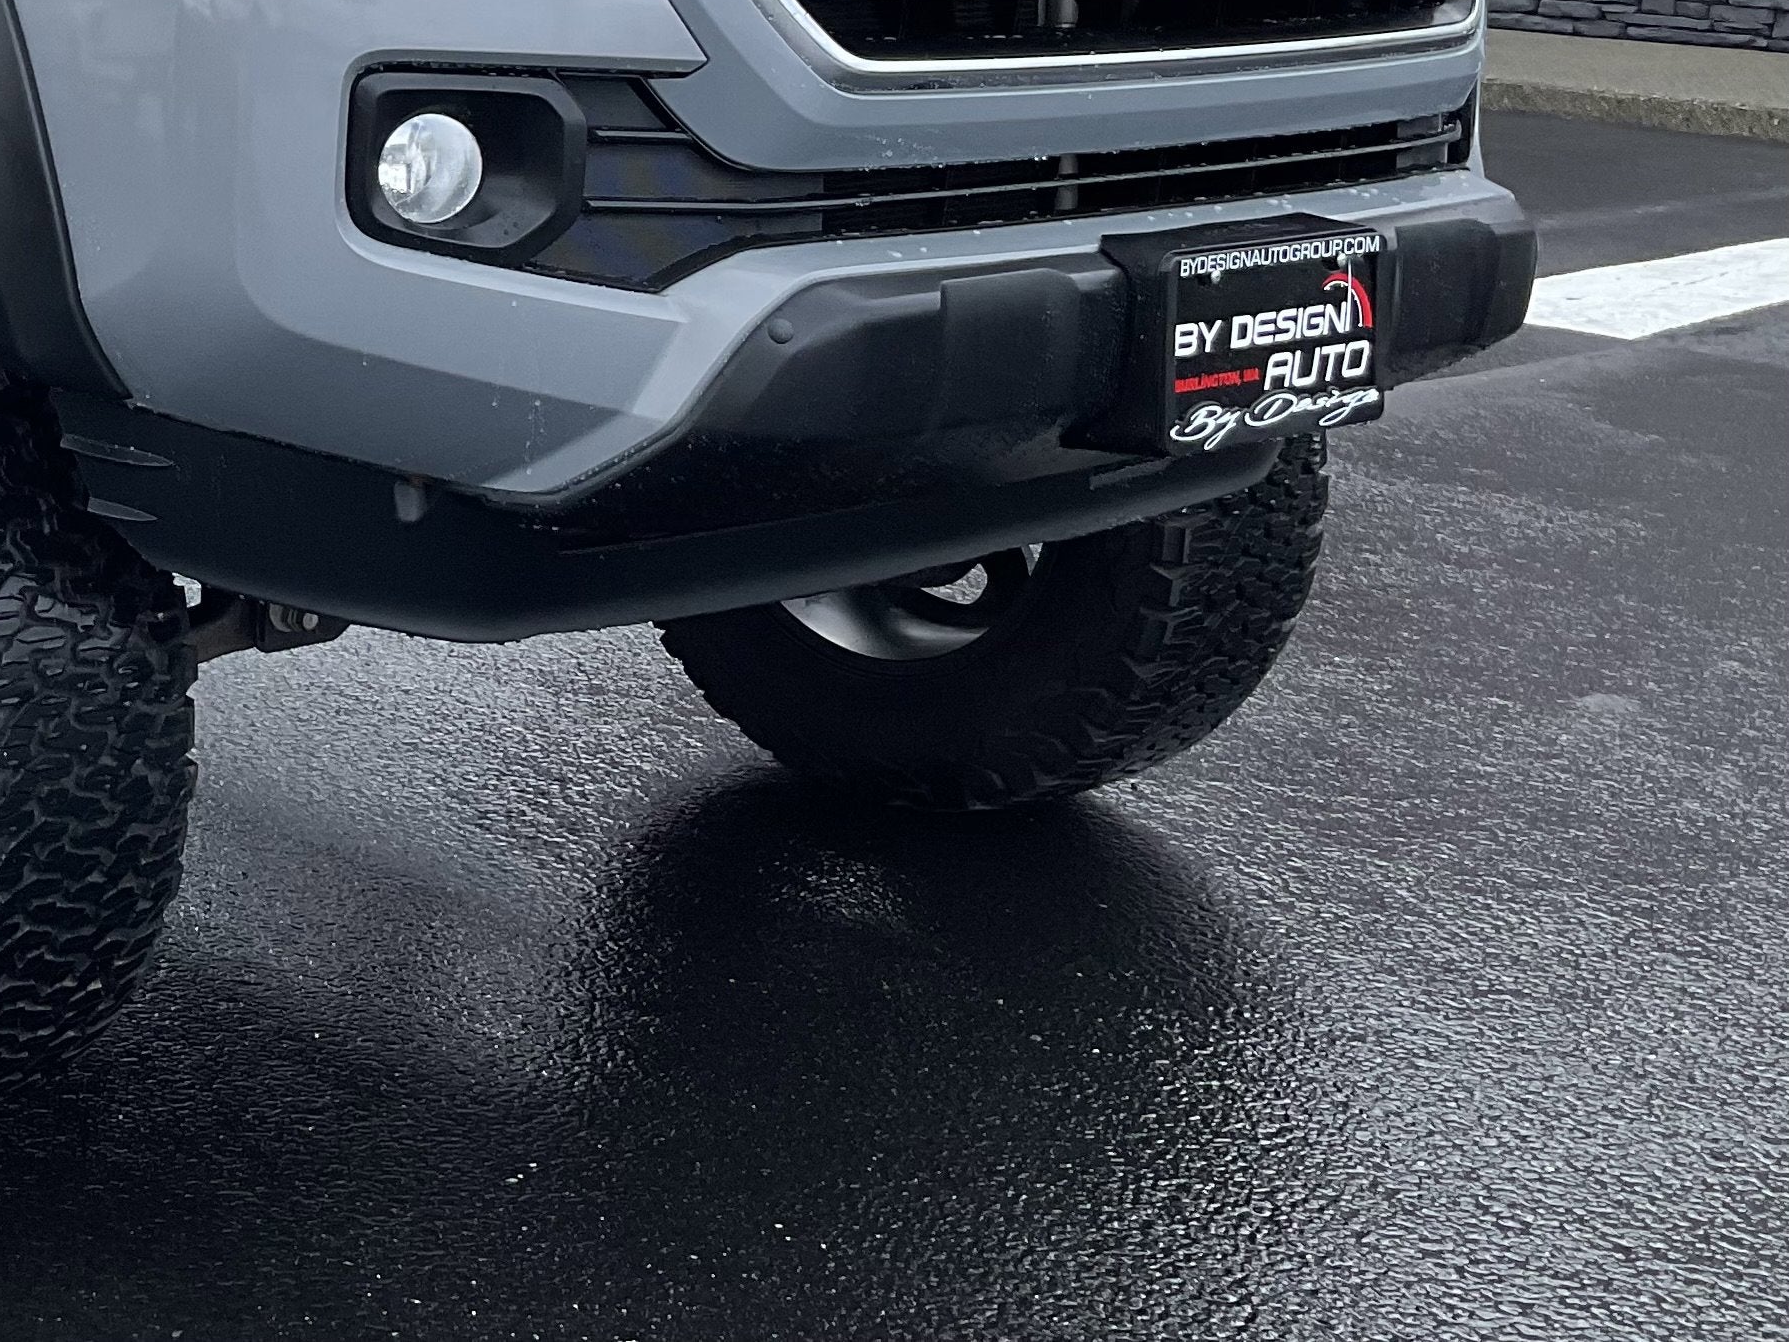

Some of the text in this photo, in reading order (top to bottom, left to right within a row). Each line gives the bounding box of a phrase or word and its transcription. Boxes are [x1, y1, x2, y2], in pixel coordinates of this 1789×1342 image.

[1179, 236, 1380, 277] BYDESIGNAUTOGROUP.COM
[1174, 303, 1349, 357] BY DESIGN
[1263, 339, 1371, 391] AUTO
[1169, 405, 1241, 451] By
